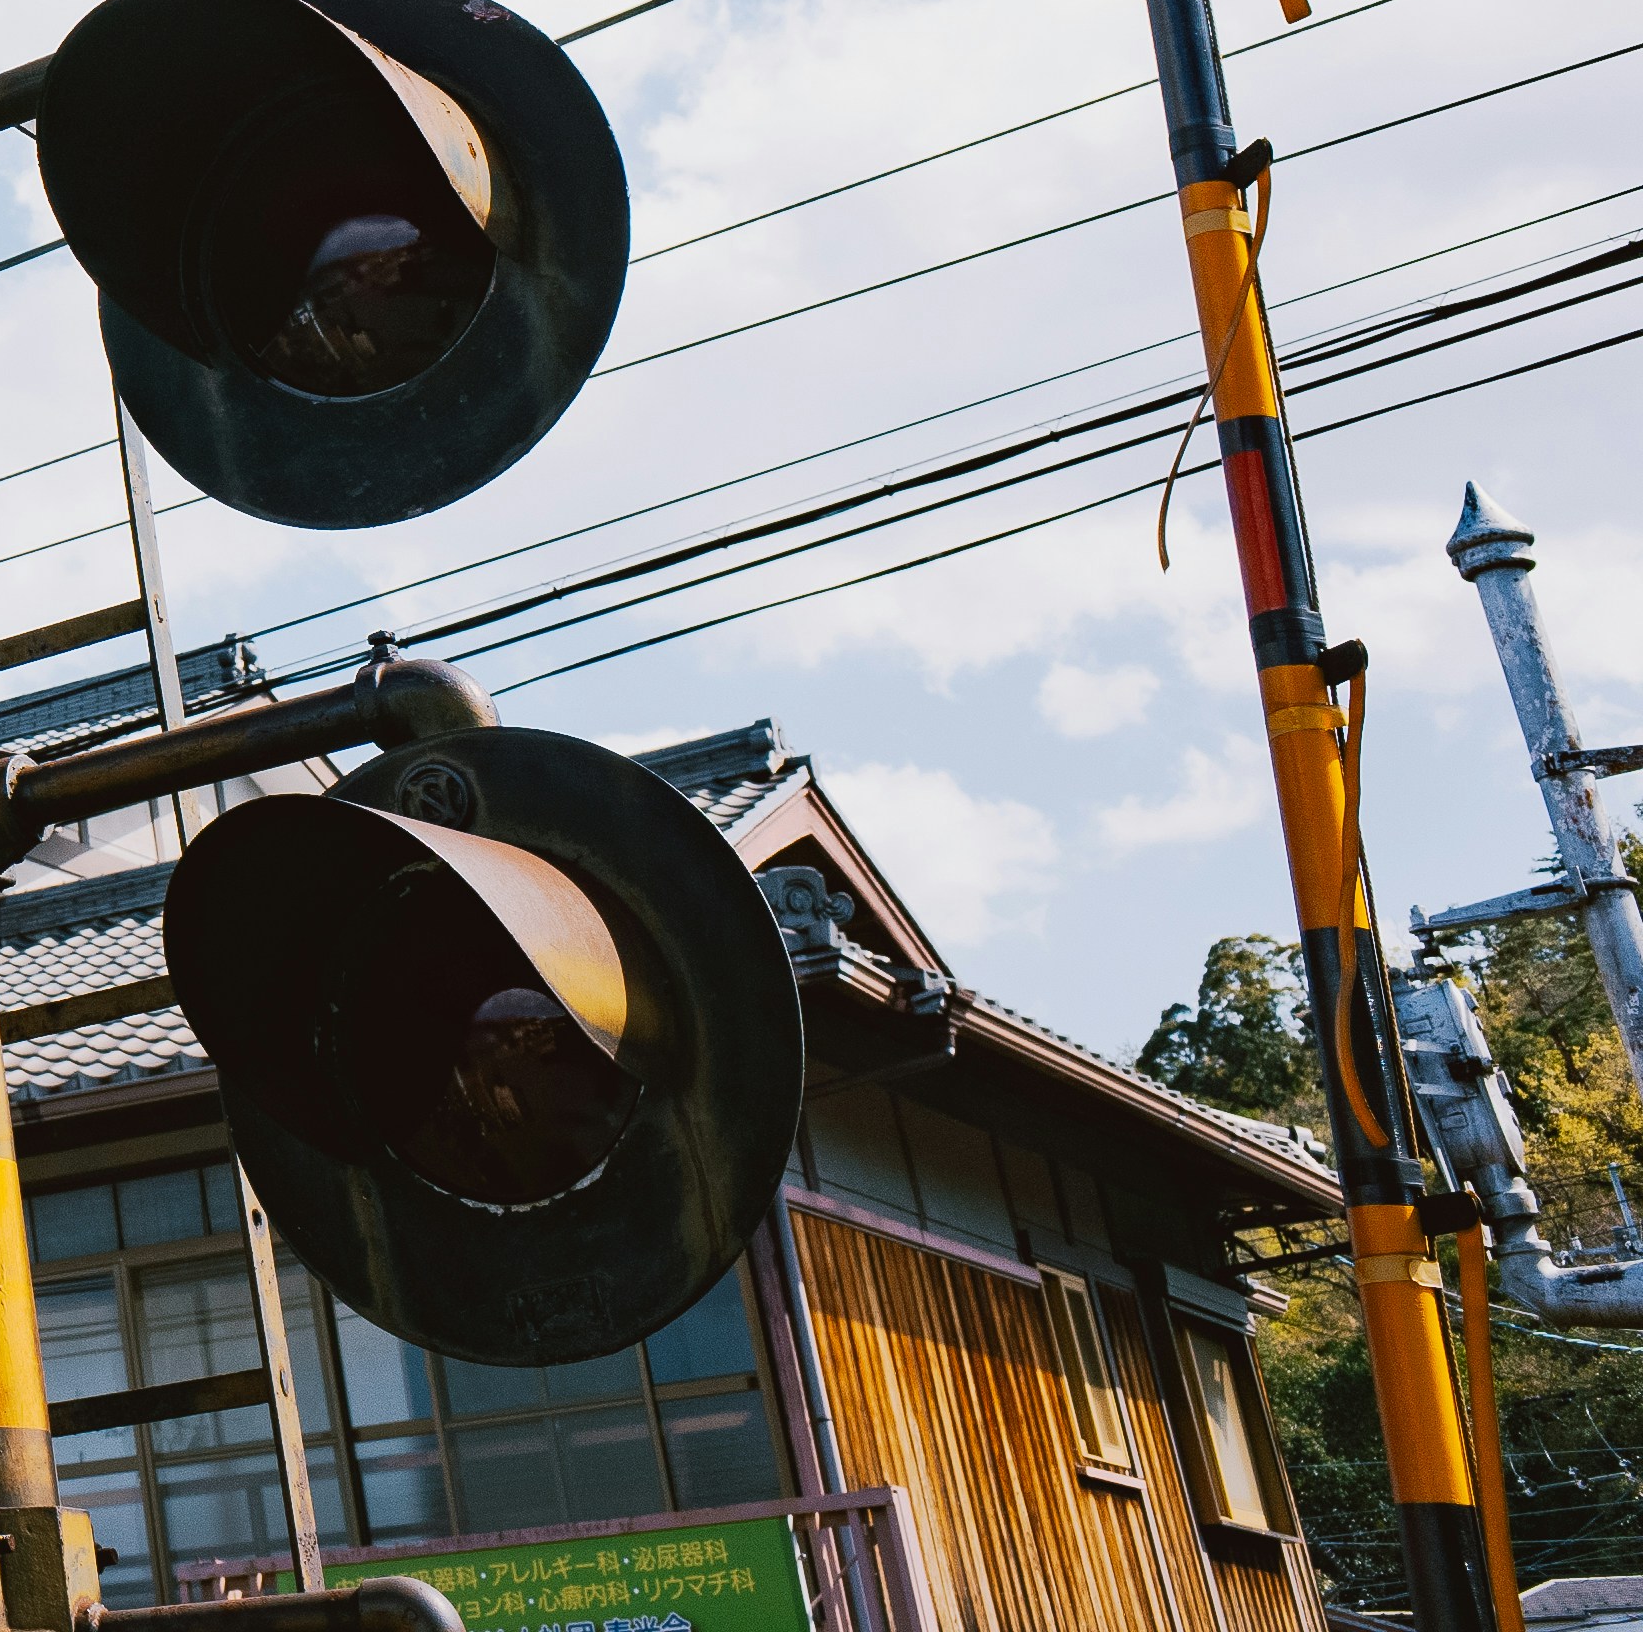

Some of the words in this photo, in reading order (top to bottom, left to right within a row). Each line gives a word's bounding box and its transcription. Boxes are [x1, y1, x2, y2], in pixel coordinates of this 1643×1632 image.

[458, 1568, 756, 1619] ョン科・心療内科・リウマチ科
